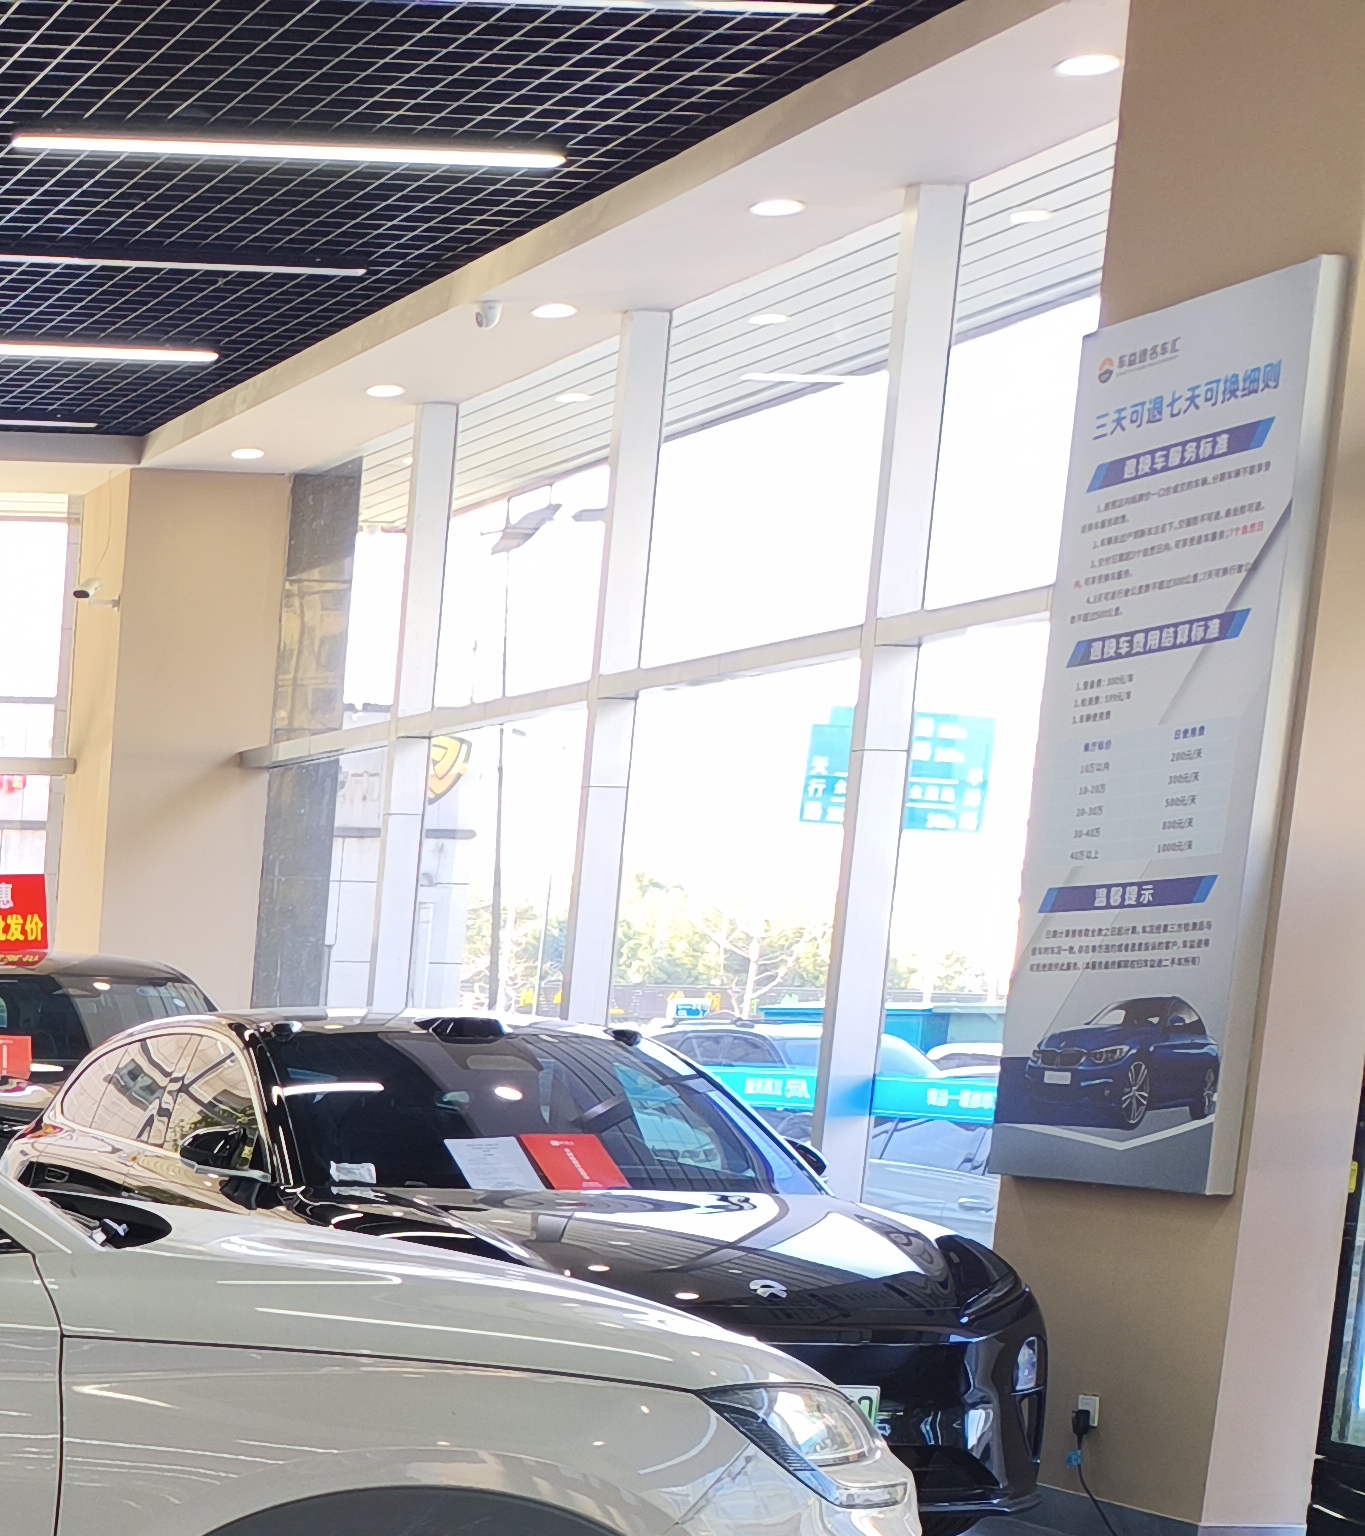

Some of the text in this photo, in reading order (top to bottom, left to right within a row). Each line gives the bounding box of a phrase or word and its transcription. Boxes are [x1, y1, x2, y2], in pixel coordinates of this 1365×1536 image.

[1092, 359, 1282, 440] 三天可退七天可换细则
